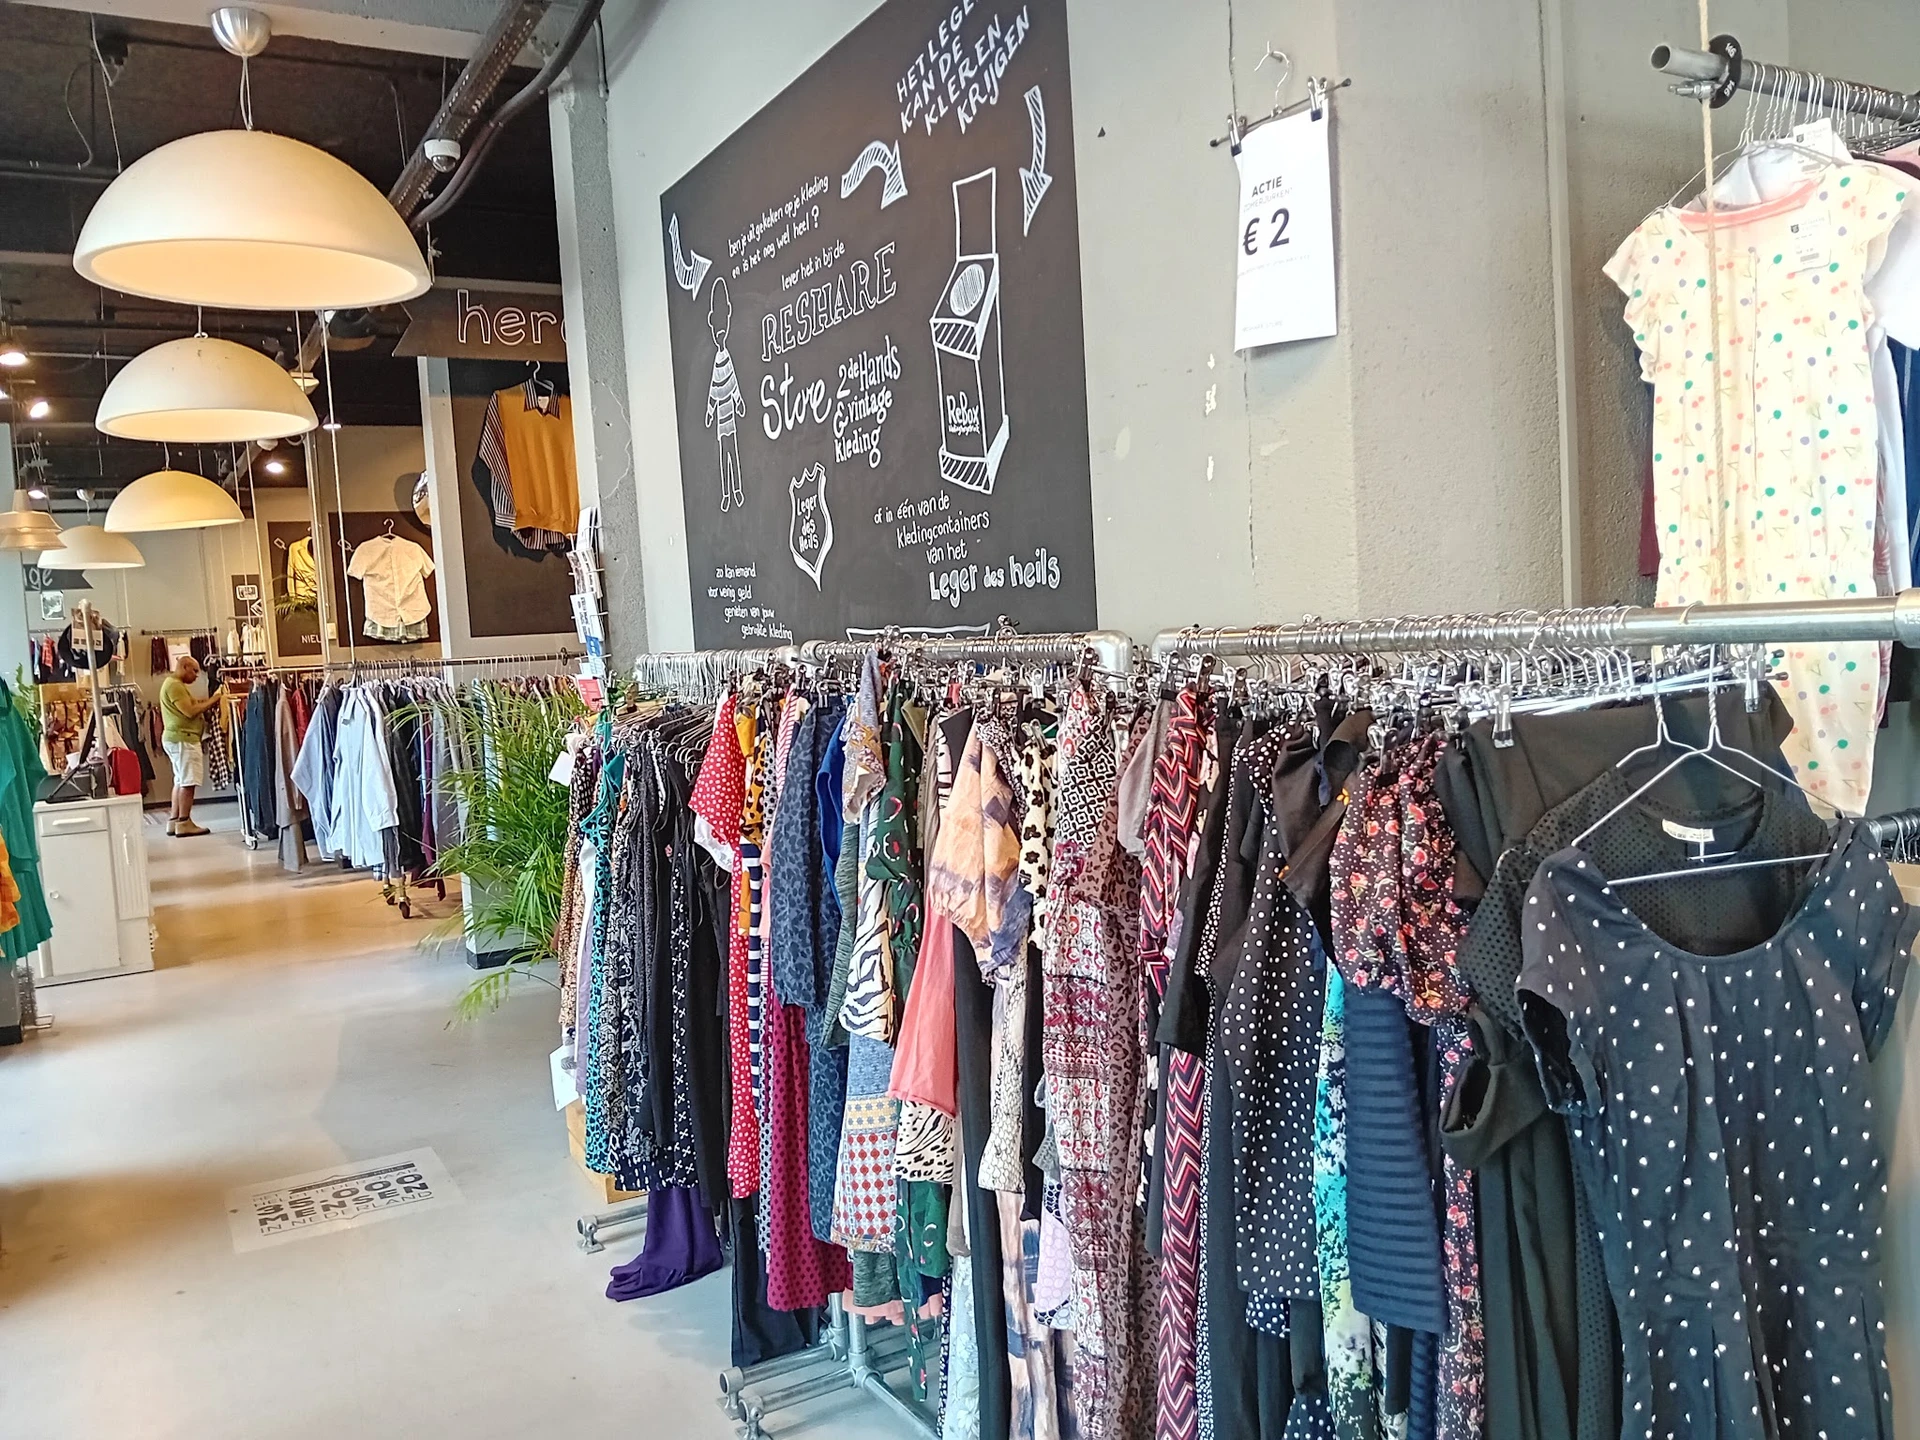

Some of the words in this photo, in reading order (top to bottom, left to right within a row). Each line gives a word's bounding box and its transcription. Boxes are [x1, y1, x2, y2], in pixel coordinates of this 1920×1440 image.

[896, 53, 924, 103] HET
[928, 0, 976, 63] LEGE
[925, 14, 1001, 136] KLEREN
[956, 5, 1030, 135] KRIJGEN
[901, 69, 935, 134] KAN
[938, 35, 962, 83] DE
[801, 175, 829, 205] kleding
[1251, 175, 1282, 198] ACTIE
[732, 266, 740, 279] en
[749, 249, 761, 269] het
[763, 243, 776, 259] nog
[776, 224, 791, 249] wel
[793, 212, 810, 239] heel
[811, 205, 820, 229] ?
[1242, 217, 1261, 256] €
[1269, 207, 1290, 249] 2
[781, 269, 800, 291] lever
[800, 257, 815, 280] het
[814, 256, 822, 272] in
[822, 246, 833, 268] bij
[833, 239, 846, 260] de
[457, 288, 567, 346] her
[761, 241, 897, 362] RESHARE
[858, 334, 902, 392] Hands
[761, 362, 833, 440] Store
[848, 385, 893, 424] vintage
[797, 494, 818, 520] Leger
[801, 518, 816, 536] des
[874, 507, 883, 524] of
[885, 507, 894, 523] in
[897, 498, 915, 520] één
[917, 496, 937, 517] van
[938, 489, 950, 511] de
[926, 547, 945, 564] van
[947, 538, 968, 561] het
[929, 563, 979, 609] Leger
[983, 565, 1005, 589] des
[1009, 548, 1061, 590] heils
[256, 1173, 423, 1216] 35.000
[258, 1182, 429, 1226] MENSEN
[260, 1223, 282, 1234] IN
[291, 1190, 434, 1227] NEDERLAND
